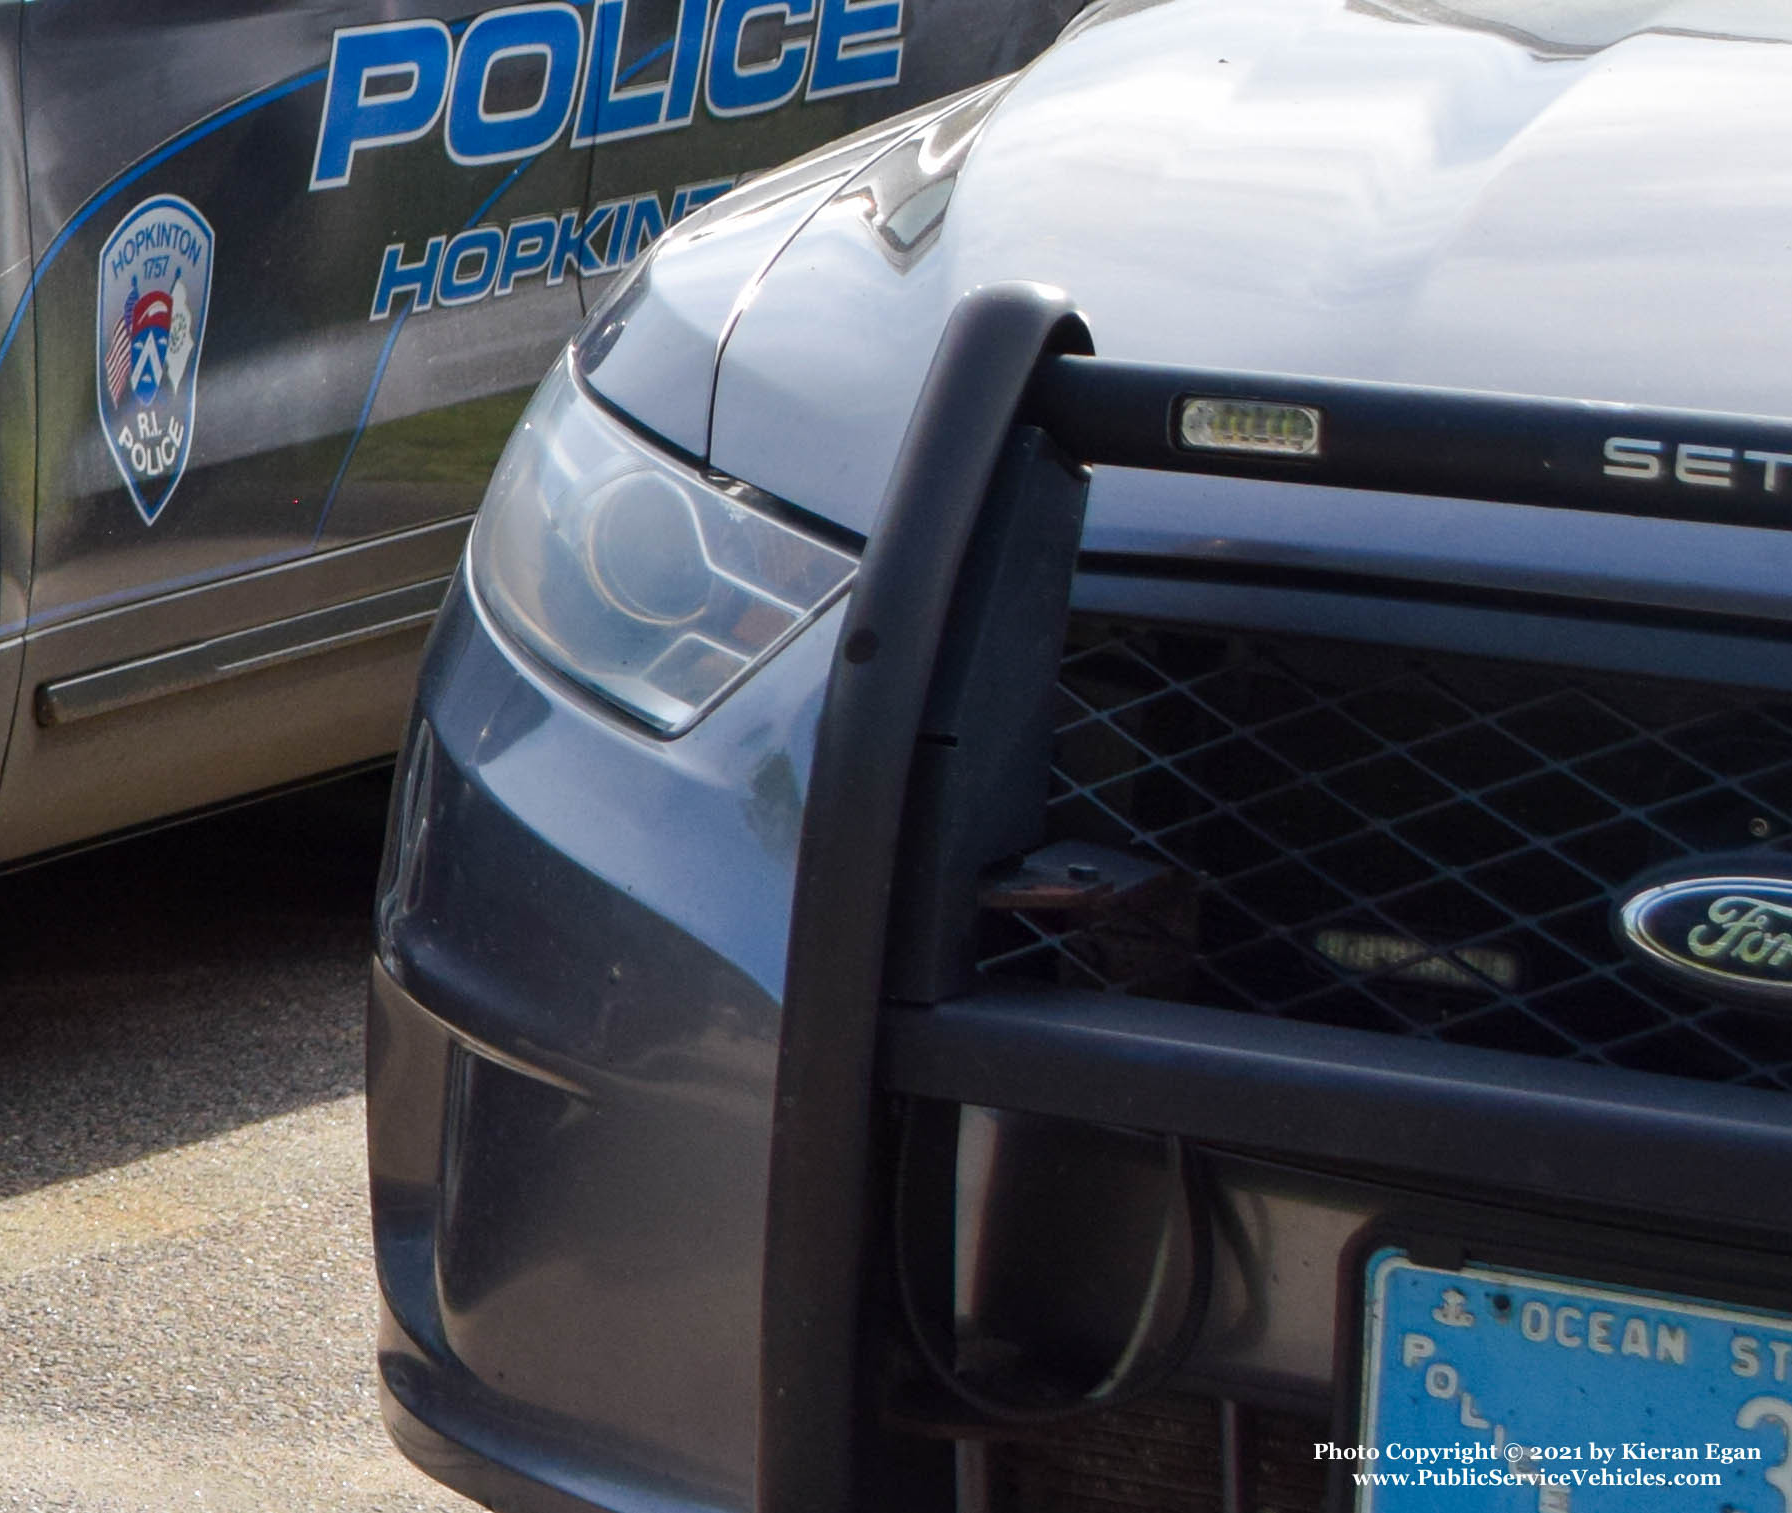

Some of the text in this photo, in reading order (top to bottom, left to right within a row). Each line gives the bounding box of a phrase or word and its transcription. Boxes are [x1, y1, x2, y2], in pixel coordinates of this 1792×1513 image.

[111, 222, 203, 278] HOPKINTON
[142, 255, 170, 280] 1757
[118, 417, 185, 475] POLICE
[1521, 1301, 1687, 1365] OCEAN
